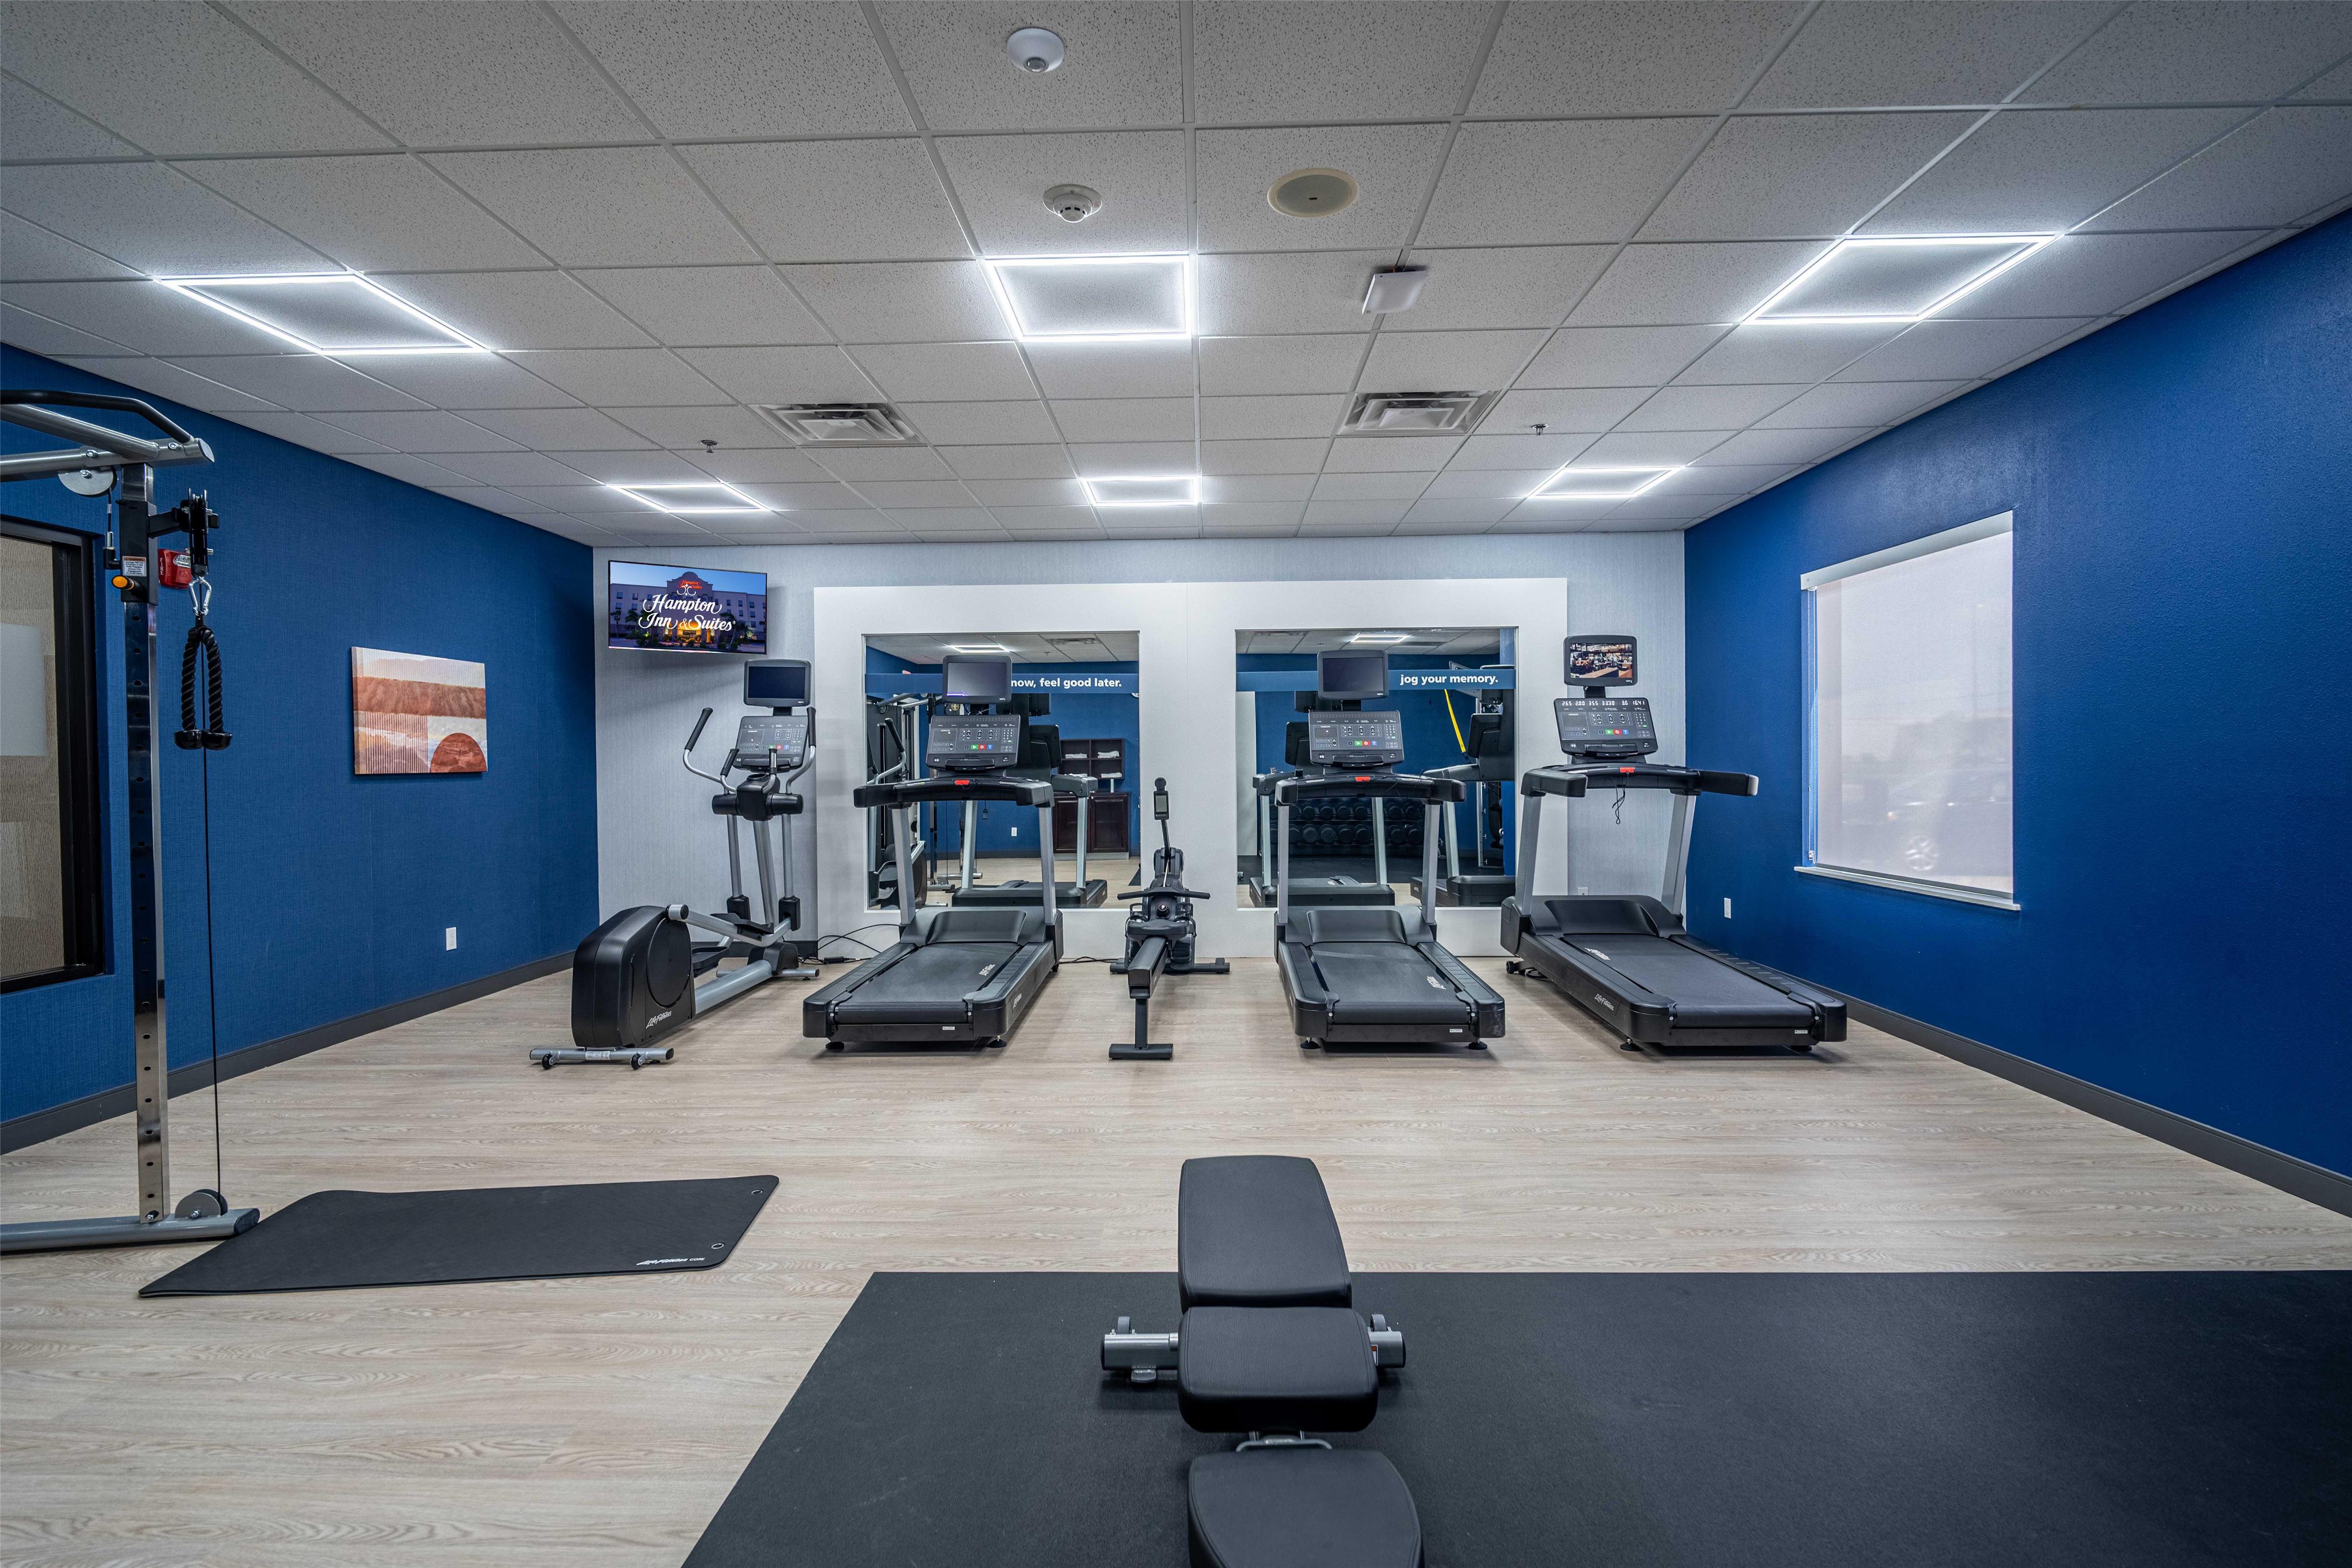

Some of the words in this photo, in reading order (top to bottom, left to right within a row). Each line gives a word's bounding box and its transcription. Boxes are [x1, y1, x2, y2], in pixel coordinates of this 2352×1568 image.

[643, 594, 722, 614] Hampton
[638, 612, 678, 629] Inn
[679, 618, 688, 628] &
[1011, 679, 1037, 688] now,
[1039, 678, 1061, 687] feel
[1063, 678, 1091, 689] good
[1094, 678, 1122, 687] later.
[1400, 674, 1418, 685] jog
[1421, 676, 1447, 685] your
[1450, 675, 1498, 685] memory.
